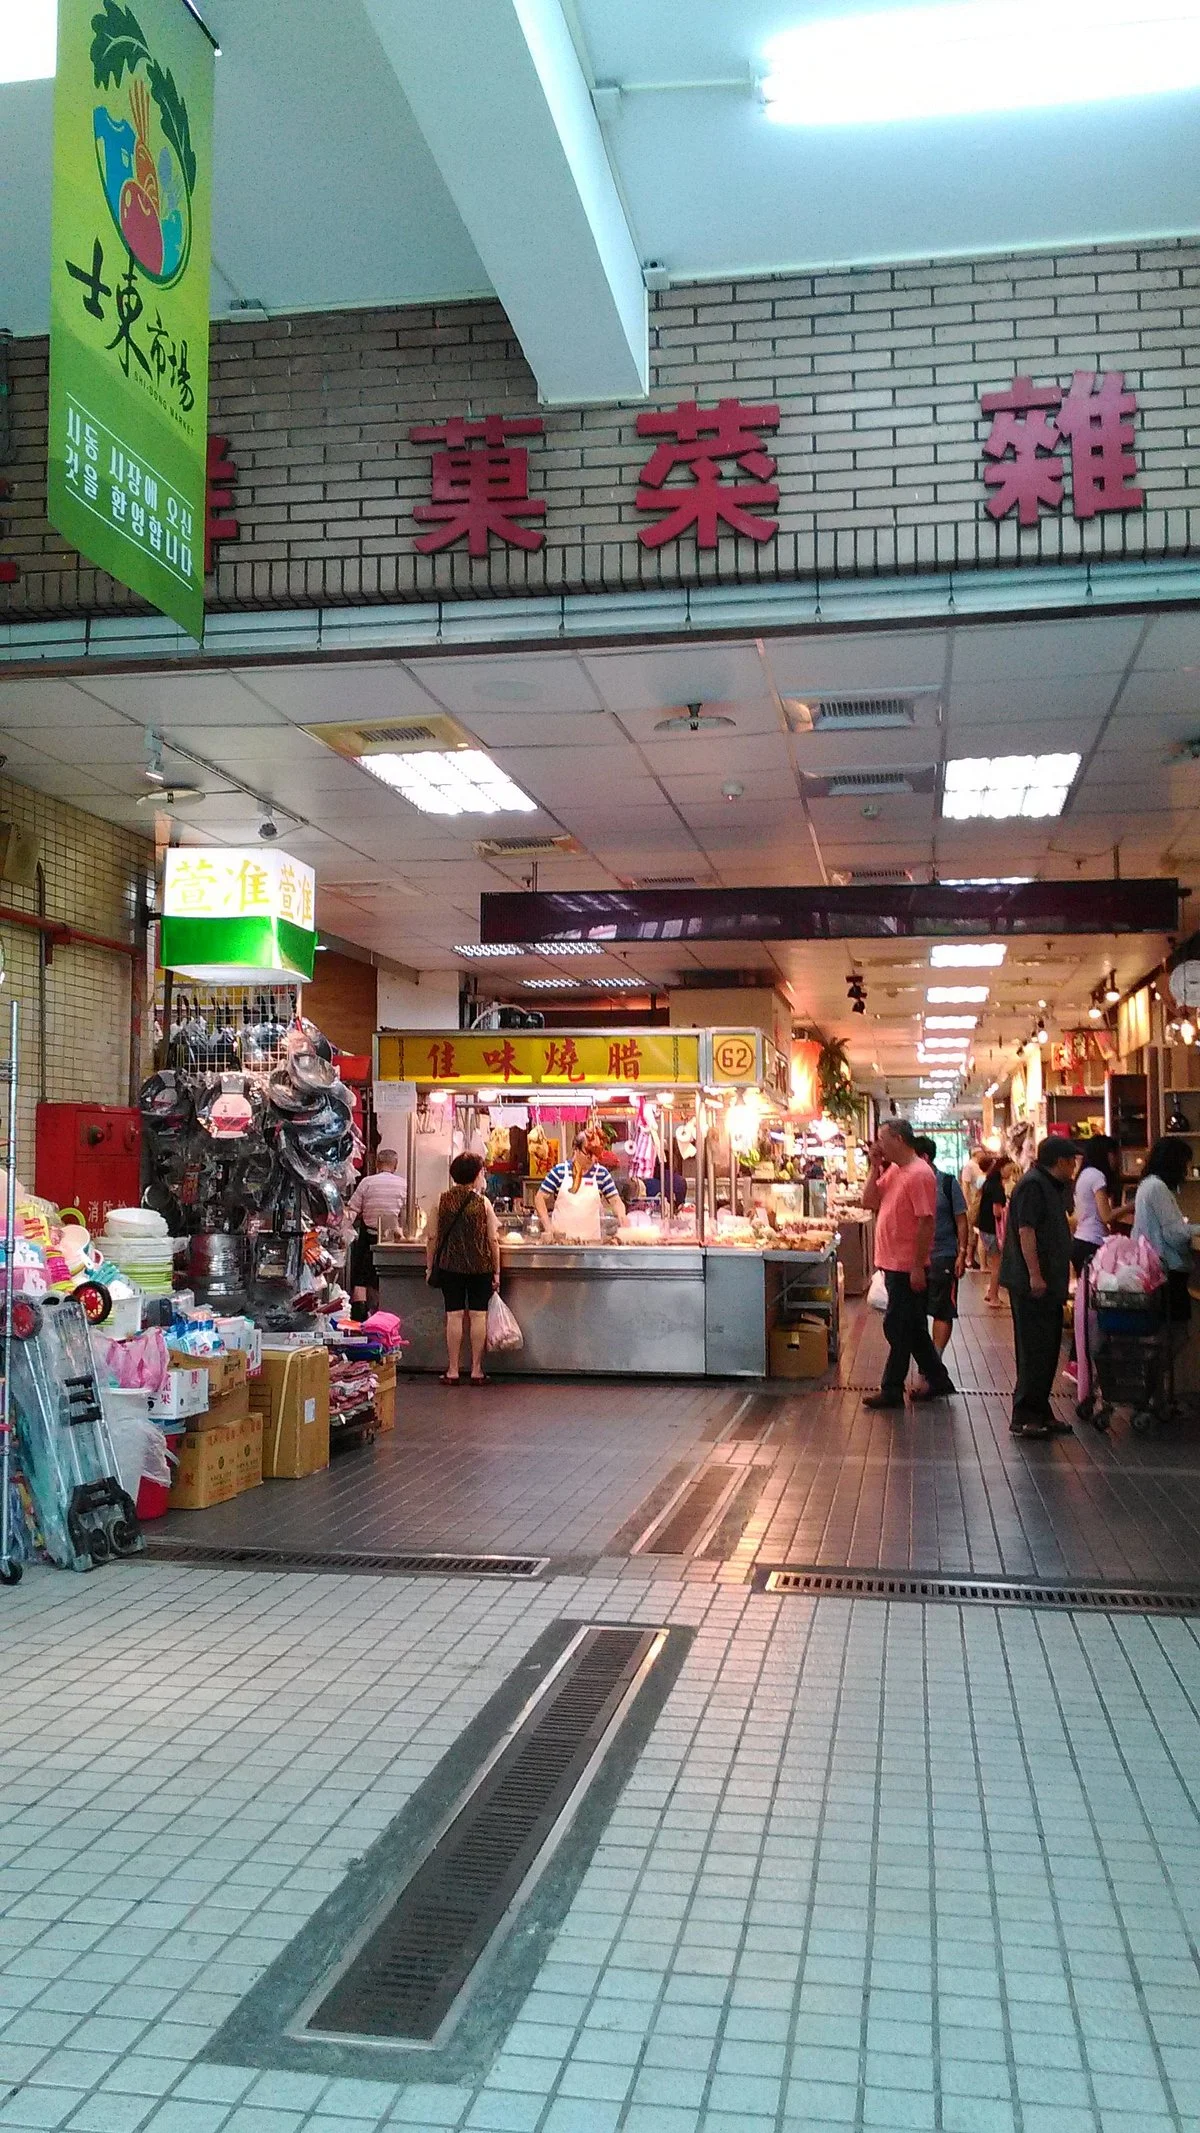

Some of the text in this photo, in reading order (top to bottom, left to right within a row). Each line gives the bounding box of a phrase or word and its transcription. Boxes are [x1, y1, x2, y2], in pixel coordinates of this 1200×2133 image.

[134, 371, 194, 437] SHI-DONG MARKET
[65, 444, 99, 500] 것을
[111, 485, 193, 578] 환영합니다
[66, 407, 192, 541] 시동 시장에 오신
[722, 1048, 748, 1068] 62
